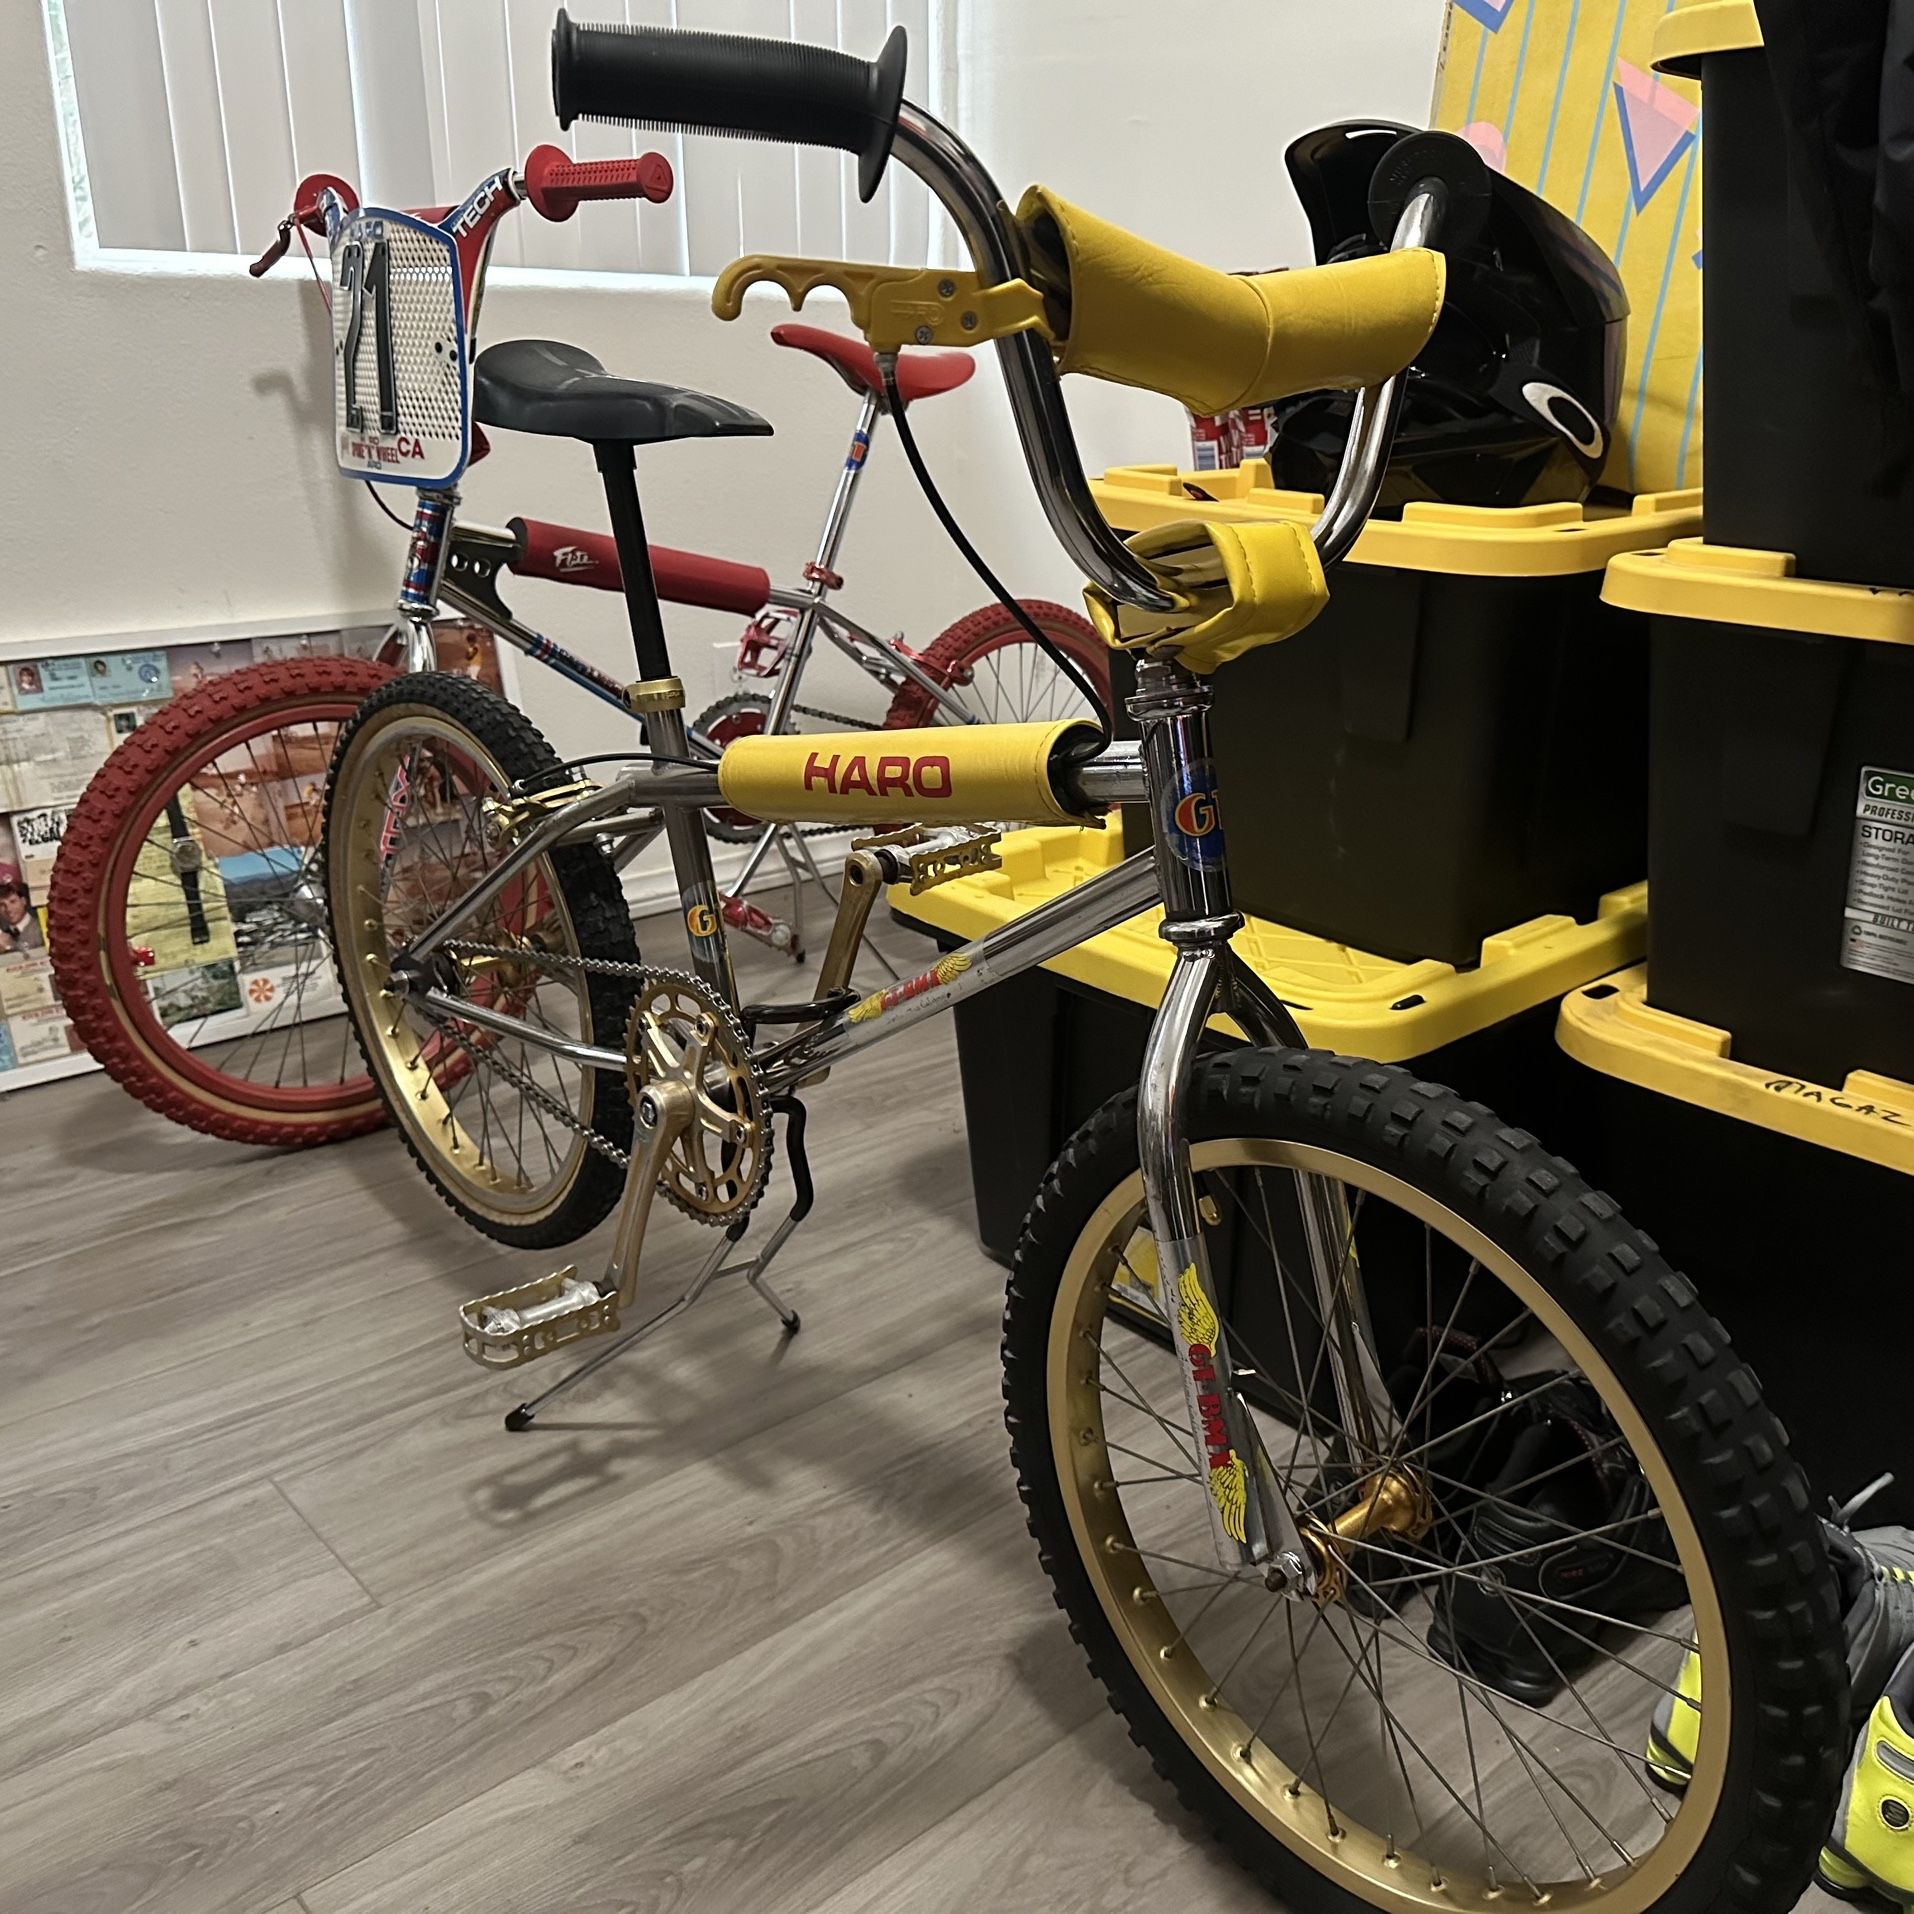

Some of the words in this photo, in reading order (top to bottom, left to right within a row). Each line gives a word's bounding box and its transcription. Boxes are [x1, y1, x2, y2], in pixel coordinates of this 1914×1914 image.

[452, 176, 503, 237] TECH
[339, 240, 398, 434] 21
[397, 436, 425, 460] CA
[803, 751, 953, 798] HARO
[1868, 776, 1914, 801] Gre
